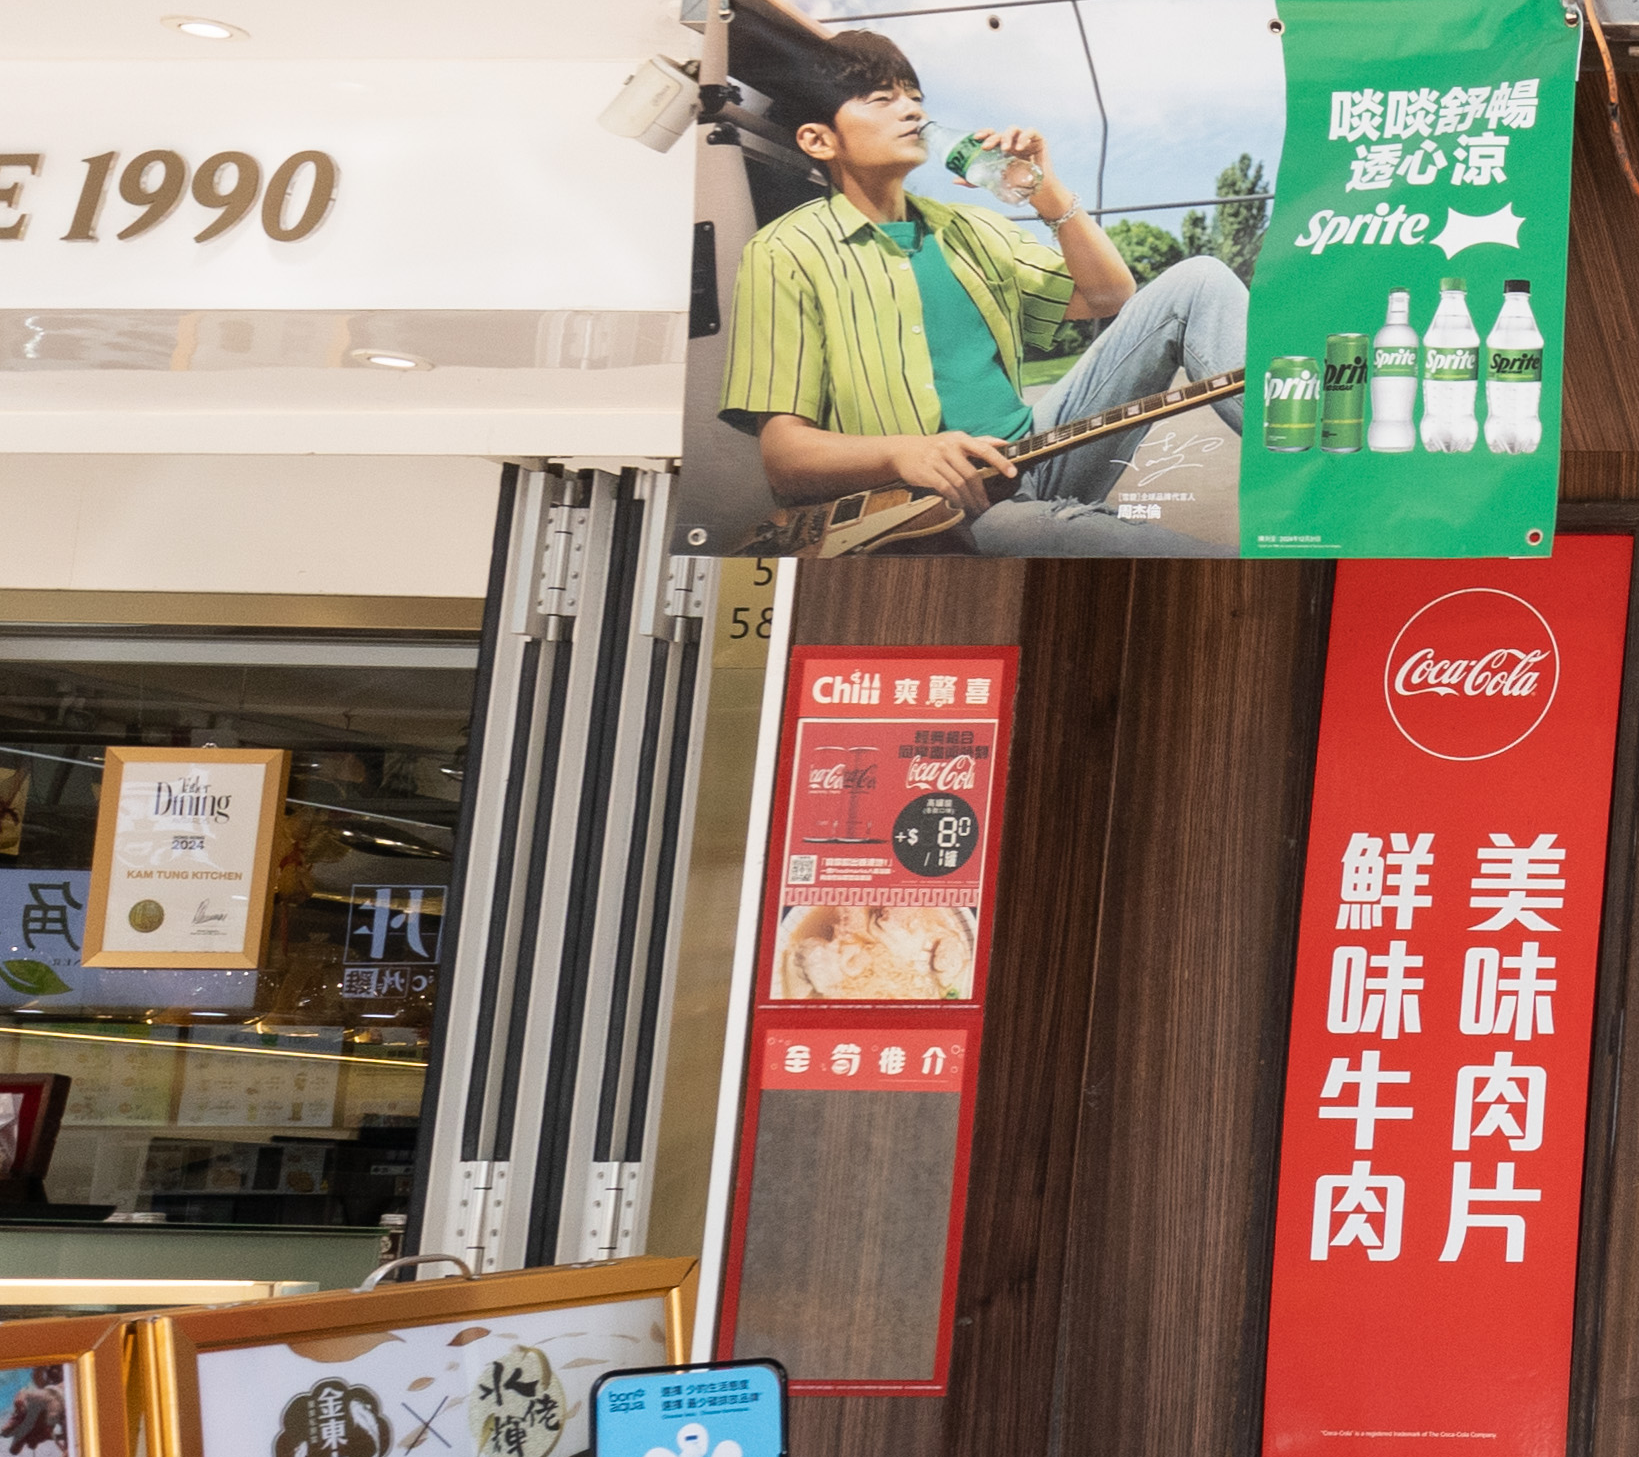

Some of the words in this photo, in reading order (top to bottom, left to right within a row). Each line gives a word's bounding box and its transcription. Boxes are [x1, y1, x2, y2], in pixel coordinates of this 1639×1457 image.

[1328, 78, 1540, 143] 啖啖舒暢
[1345, 134, 1510, 193] 透心涼
[59, 148, 341, 245] 1990
[1294, 202, 1431, 255] Sprite
[1425, 349, 1476, 371] Sprite
[730, 607, 774, 639] 58
[1394, 647, 1551, 700] Coca-Cola
[127, 870, 156, 881] KAM
[158, 870, 189, 881] TUNG
[191, 870, 243, 882] KITCHEN
[1309, 832, 1437, 1263] 鮮味牛肉
[1438, 833, 1568, 1264] 美味肉片
